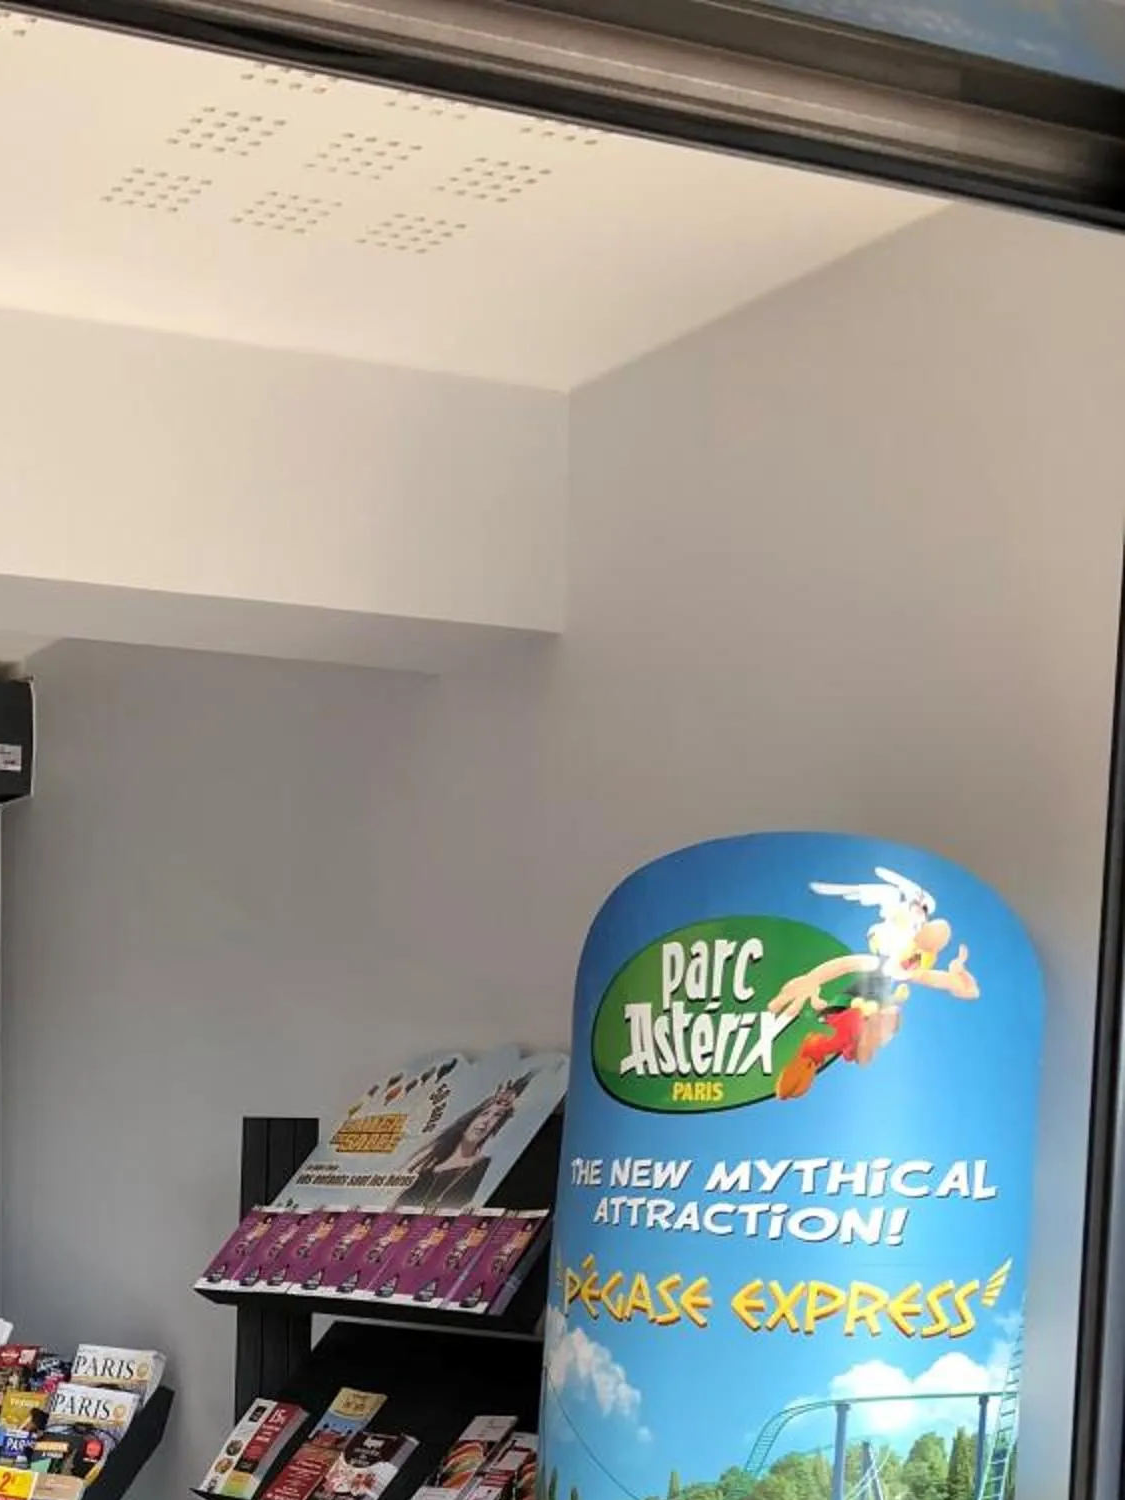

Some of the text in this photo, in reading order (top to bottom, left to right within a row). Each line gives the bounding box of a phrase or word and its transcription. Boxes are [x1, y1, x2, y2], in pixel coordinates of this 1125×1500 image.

[672, 1081, 724, 1102] PARIS
[570, 1156, 999, 1201] THE NEW MYTHICAL
[593, 1196, 910, 1246] ATTRACTION!
[730, 1278, 981, 1339] EXPRESS
[74, 1355, 136, 1381] PARIS
[51, 1393, 111, 1421] PARIS
